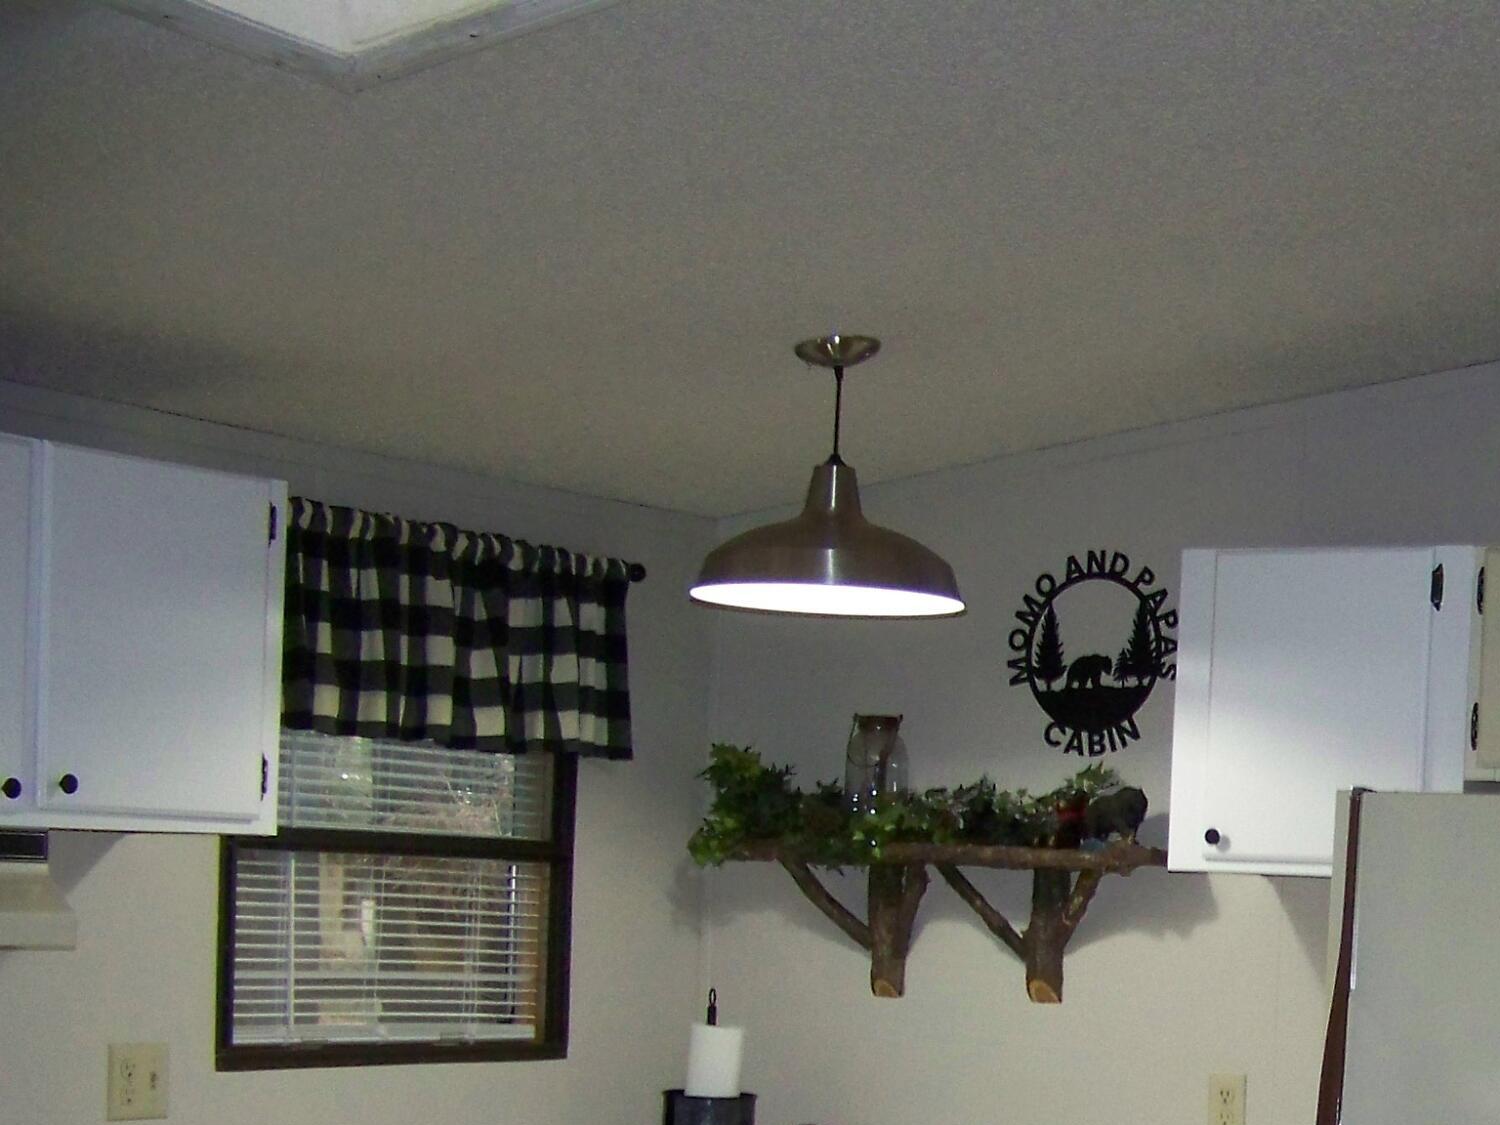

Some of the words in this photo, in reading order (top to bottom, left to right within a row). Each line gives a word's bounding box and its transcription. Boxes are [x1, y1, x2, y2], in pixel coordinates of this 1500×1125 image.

[1007, 574, 1056, 686] MOMO
[1065, 550, 1130, 581] AND
[1133, 566, 1179, 681] PAPAS
[1044, 716, 1141, 757] CABIN
